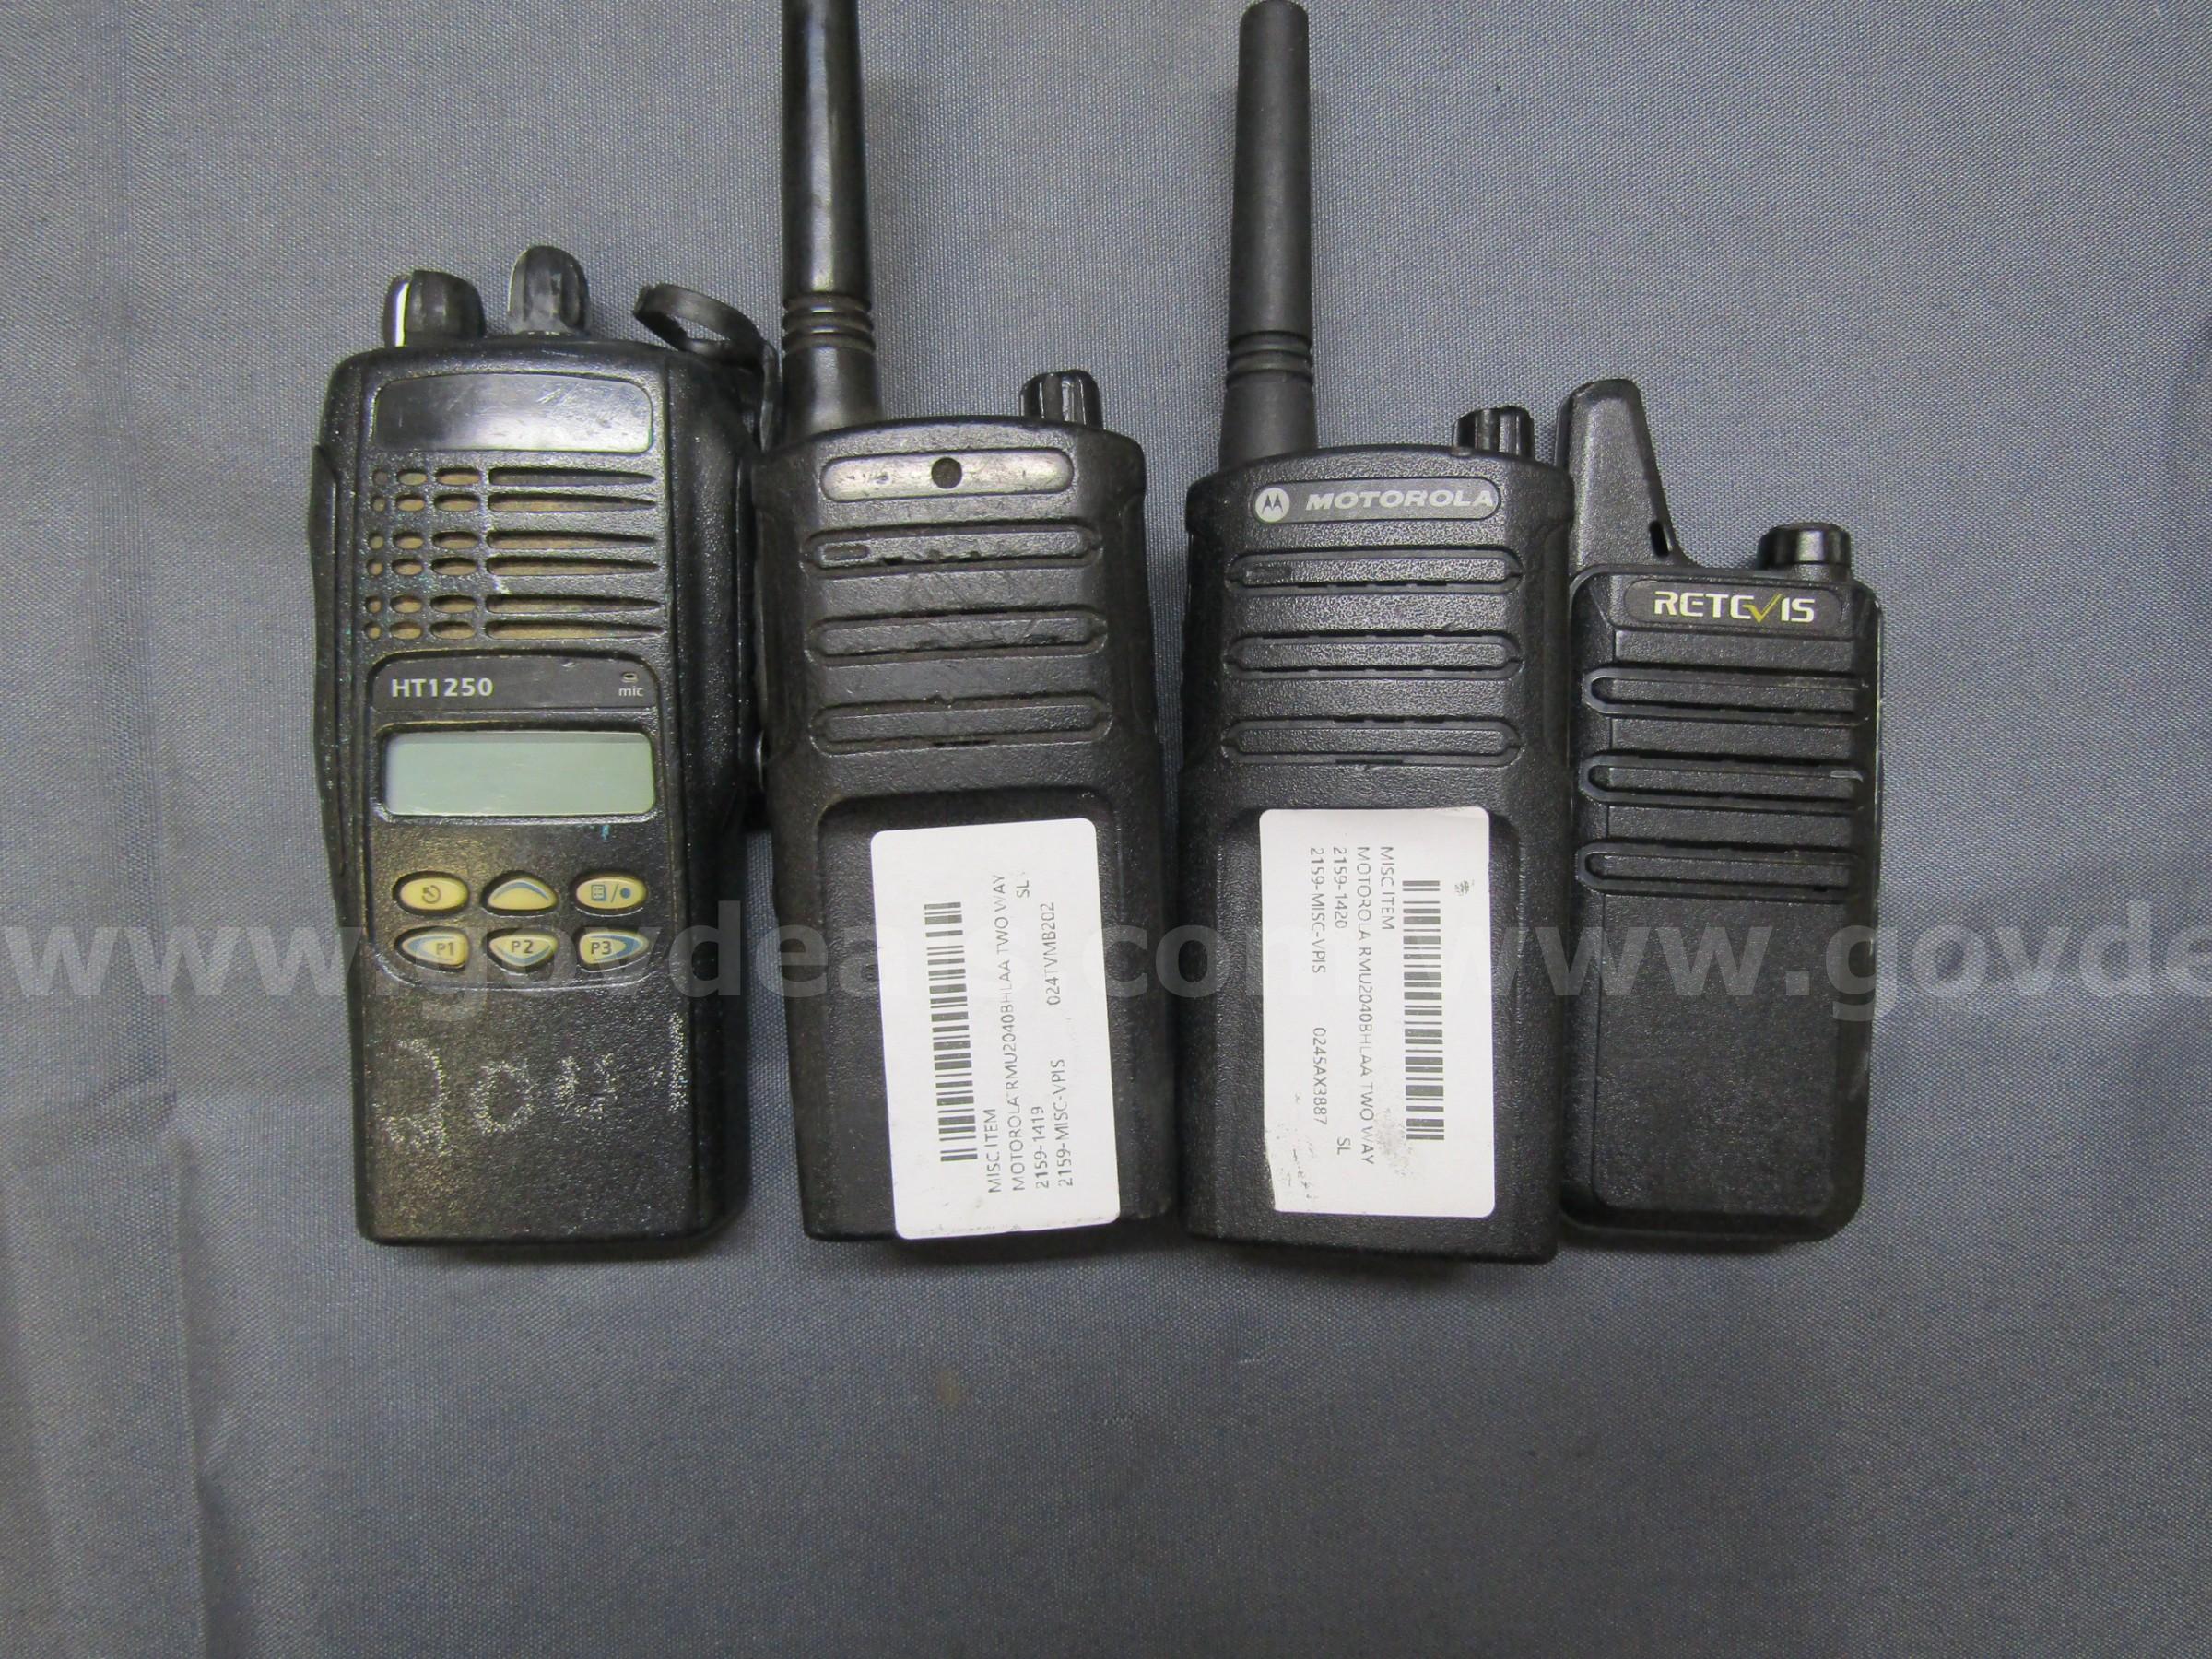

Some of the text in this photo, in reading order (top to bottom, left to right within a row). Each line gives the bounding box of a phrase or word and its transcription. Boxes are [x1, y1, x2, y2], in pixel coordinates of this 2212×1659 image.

[1304, 490, 1495, 511] MOTOROLA
[391, 677, 494, 698] HT1250
[618, 686, 644, 697] mic
[993, 875, 1007, 912] WAY
[1356, 846, 1372, 941] MOTOROLA
[1380, 846, 1395, 930] MISC ITEM
[1310, 847, 1326, 973] 2159-MISC-VPIS
[435, 941, 455, 956] P1
[510, 939, 535, 955] P2
[589, 940, 613, 955] P3
[994, 916, 1010, 955] TWO
[1333, 846, 1351, 1156] 2159-1420 SL
[1016, 880, 1050, 1189] 2159-1419 SL
[1359, 1081, 1375, 1121] TWO
[1050, 1058, 1074, 1187] 2159-MISC-VPIS
[982, 1108, 1002, 1193] MISC ITEM
[1006, 1095, 1025, 1191] MOTOROLA
[1360, 1125, 1375, 1165] WAY
